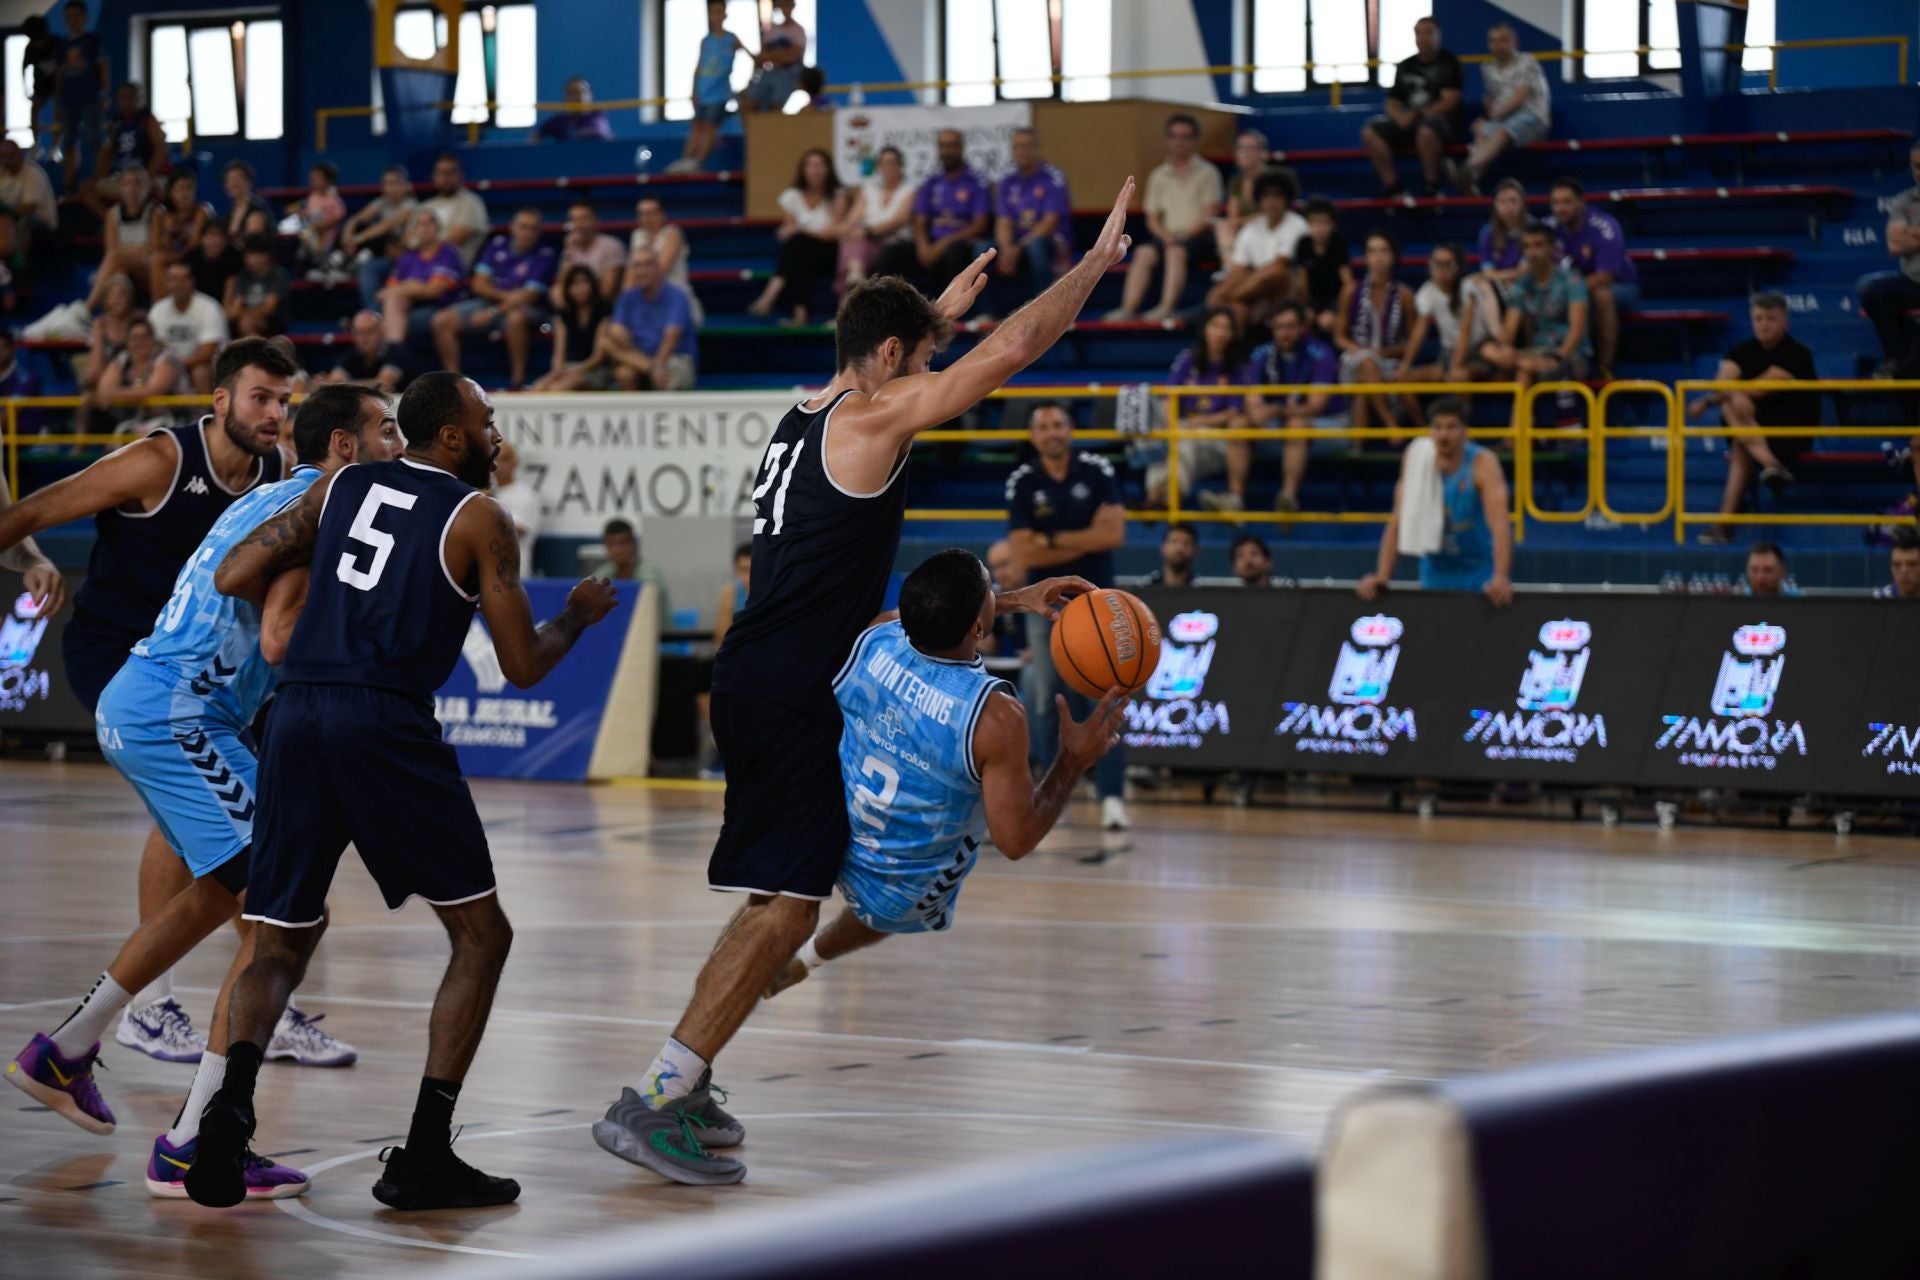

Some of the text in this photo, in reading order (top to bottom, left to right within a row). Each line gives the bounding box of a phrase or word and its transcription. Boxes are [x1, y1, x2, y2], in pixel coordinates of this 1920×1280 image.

[752, 438, 805, 535] 21
[336, 482, 419, 592] 5
[1104, 593, 1137, 665] Wilson
[867, 648, 954, 726] WINTERING
[852, 754, 900, 832] 2
[899, 748, 931, 771] salud
